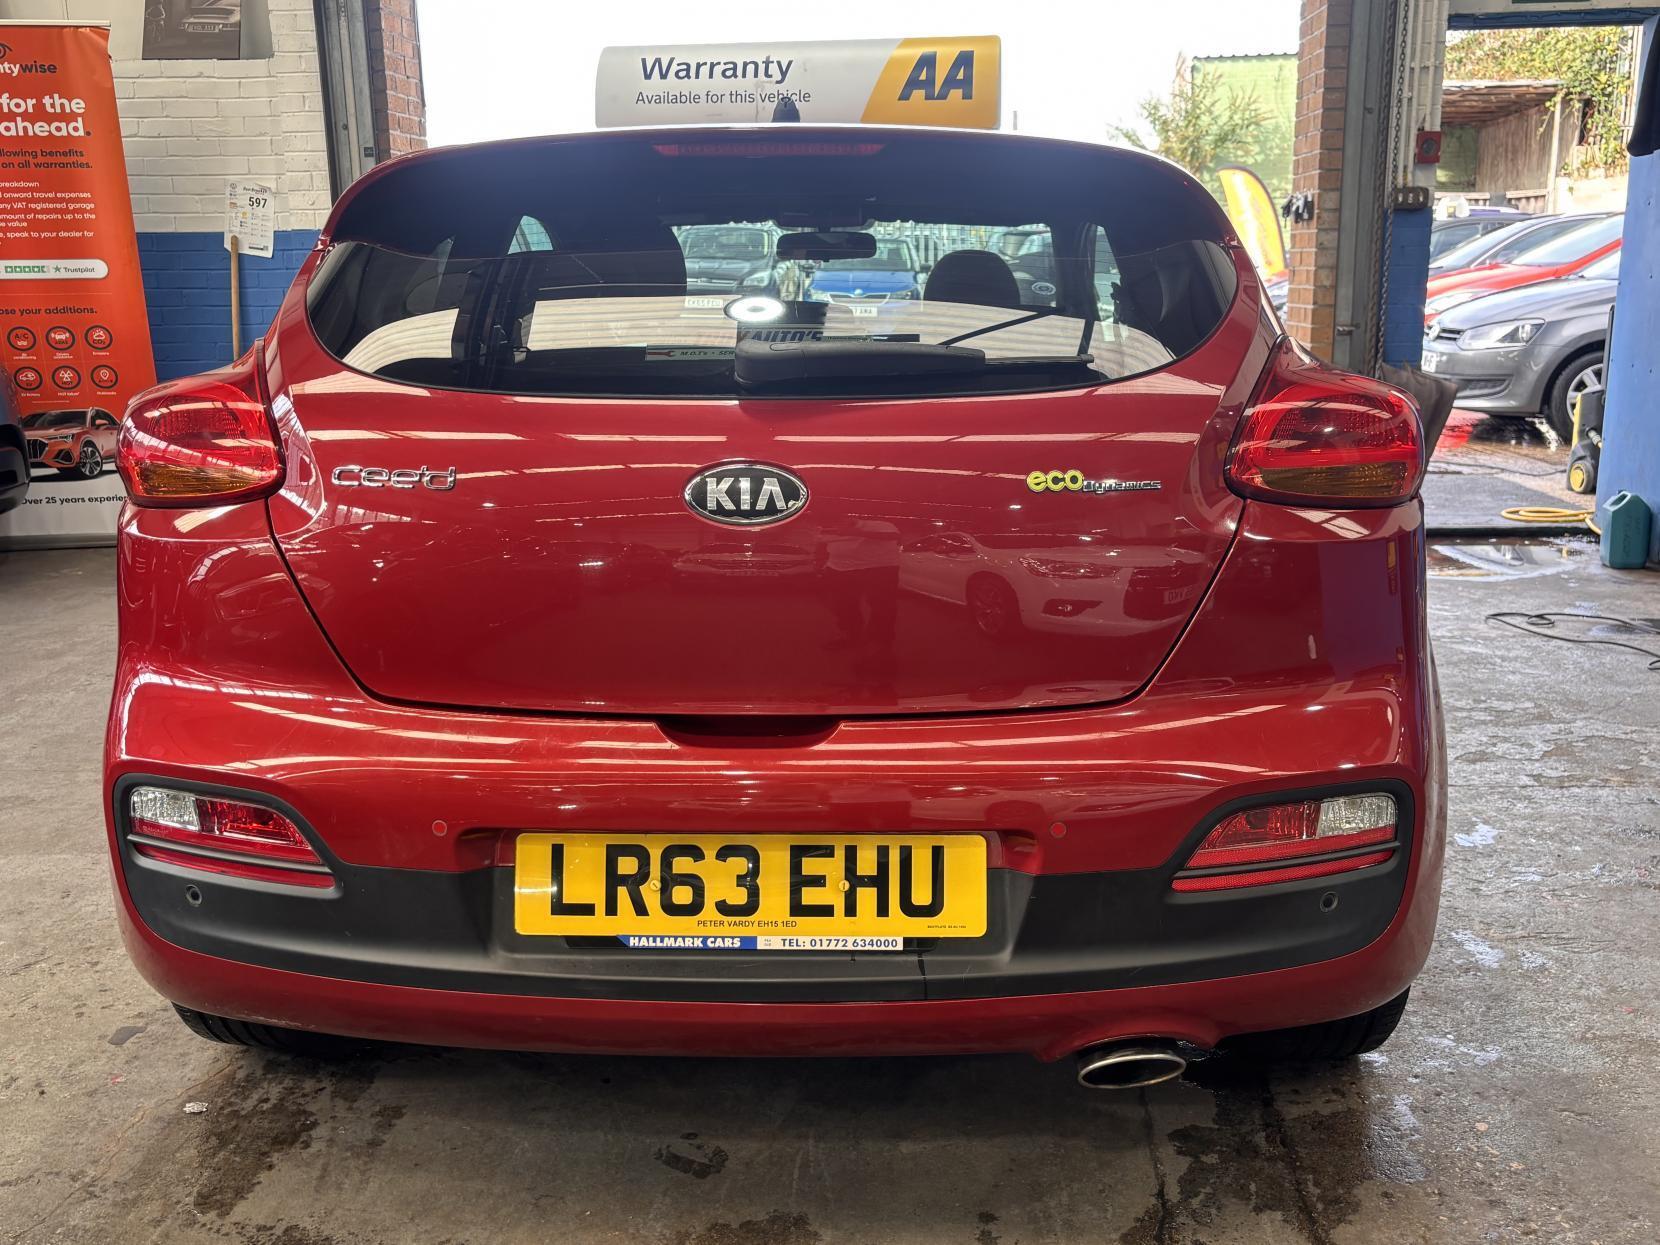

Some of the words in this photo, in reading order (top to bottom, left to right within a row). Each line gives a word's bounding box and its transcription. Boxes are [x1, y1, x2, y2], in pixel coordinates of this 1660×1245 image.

[640, 55, 794, 84] Warranty
[897, 50, 975, 101] AA
[636, 91, 701, 104] Available
[705, 91, 726, 103] for
[729, 90, 755, 103] this
[0, 93, 36, 113] for
[43, 94, 85, 113] the
[0, 117, 91, 136] ahead.
[41, 149, 84, 157] benefits
[18, 160, 30, 168] all
[33, 160, 93, 168] warranties.
[248, 197, 267, 208] 597
[7, 231, 29, 239] speak
[63, 266, 95, 274] Trustpilot
[18, 308, 41, 317] your
[44, 306, 97, 315] additions.
[706, 477, 787, 511] KIA
[60, 497, 86, 505] years
[551, 843, 760, 917] LR63
[789, 844, 945, 918] EHU
[697, 920, 725, 928] PETER
[727, 920, 755, 928] VARDY
[758, 920, 779, 928] EH15
[781, 920, 797, 928] 1ED
[629, 936, 703, 948] HALLMARK
[706, 937, 741, 948] CARS
[781, 938, 806, 948] TEL:
[810, 938, 848, 948] 01772
[852, 938, 898, 948] 634000
